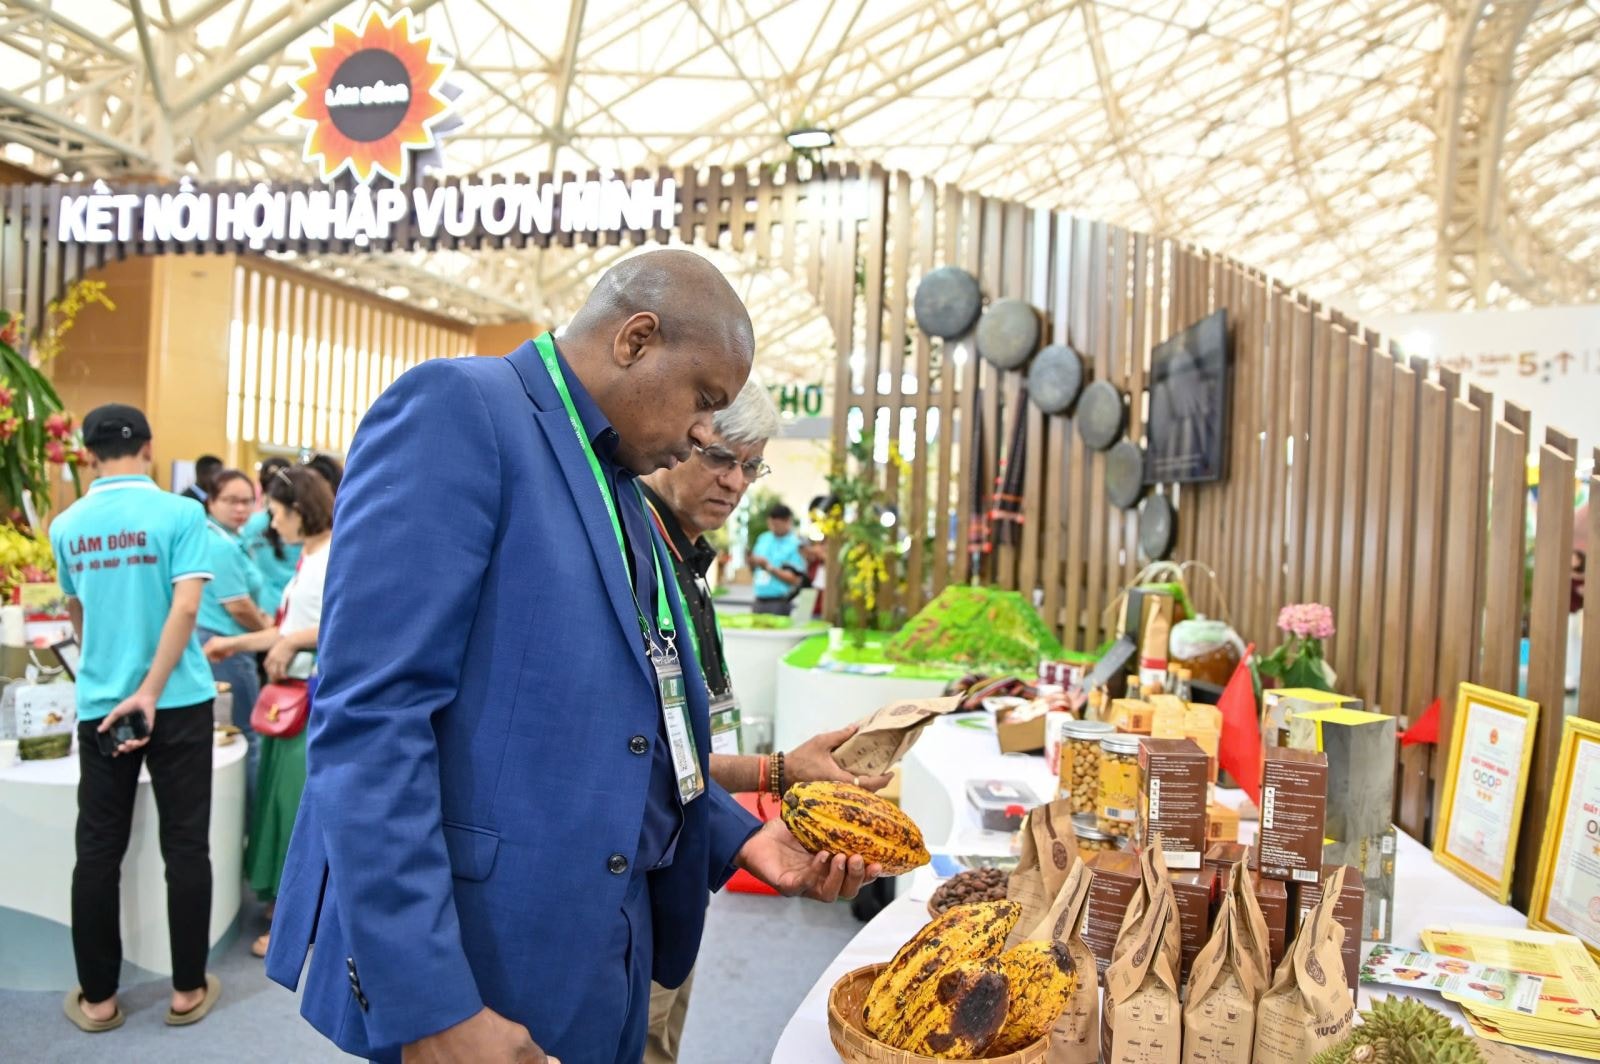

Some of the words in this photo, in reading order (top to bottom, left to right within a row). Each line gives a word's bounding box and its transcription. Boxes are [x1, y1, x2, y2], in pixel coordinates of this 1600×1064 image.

[142, 175, 211, 242] NỐI
[215, 183, 286, 250] HỘI
[289, 183, 407, 247] NHẬP
[412, 182, 552, 238] VƯƠN
[70, 535, 102, 555] LÂM
[1472, 769, 1502, 788] OCOP
